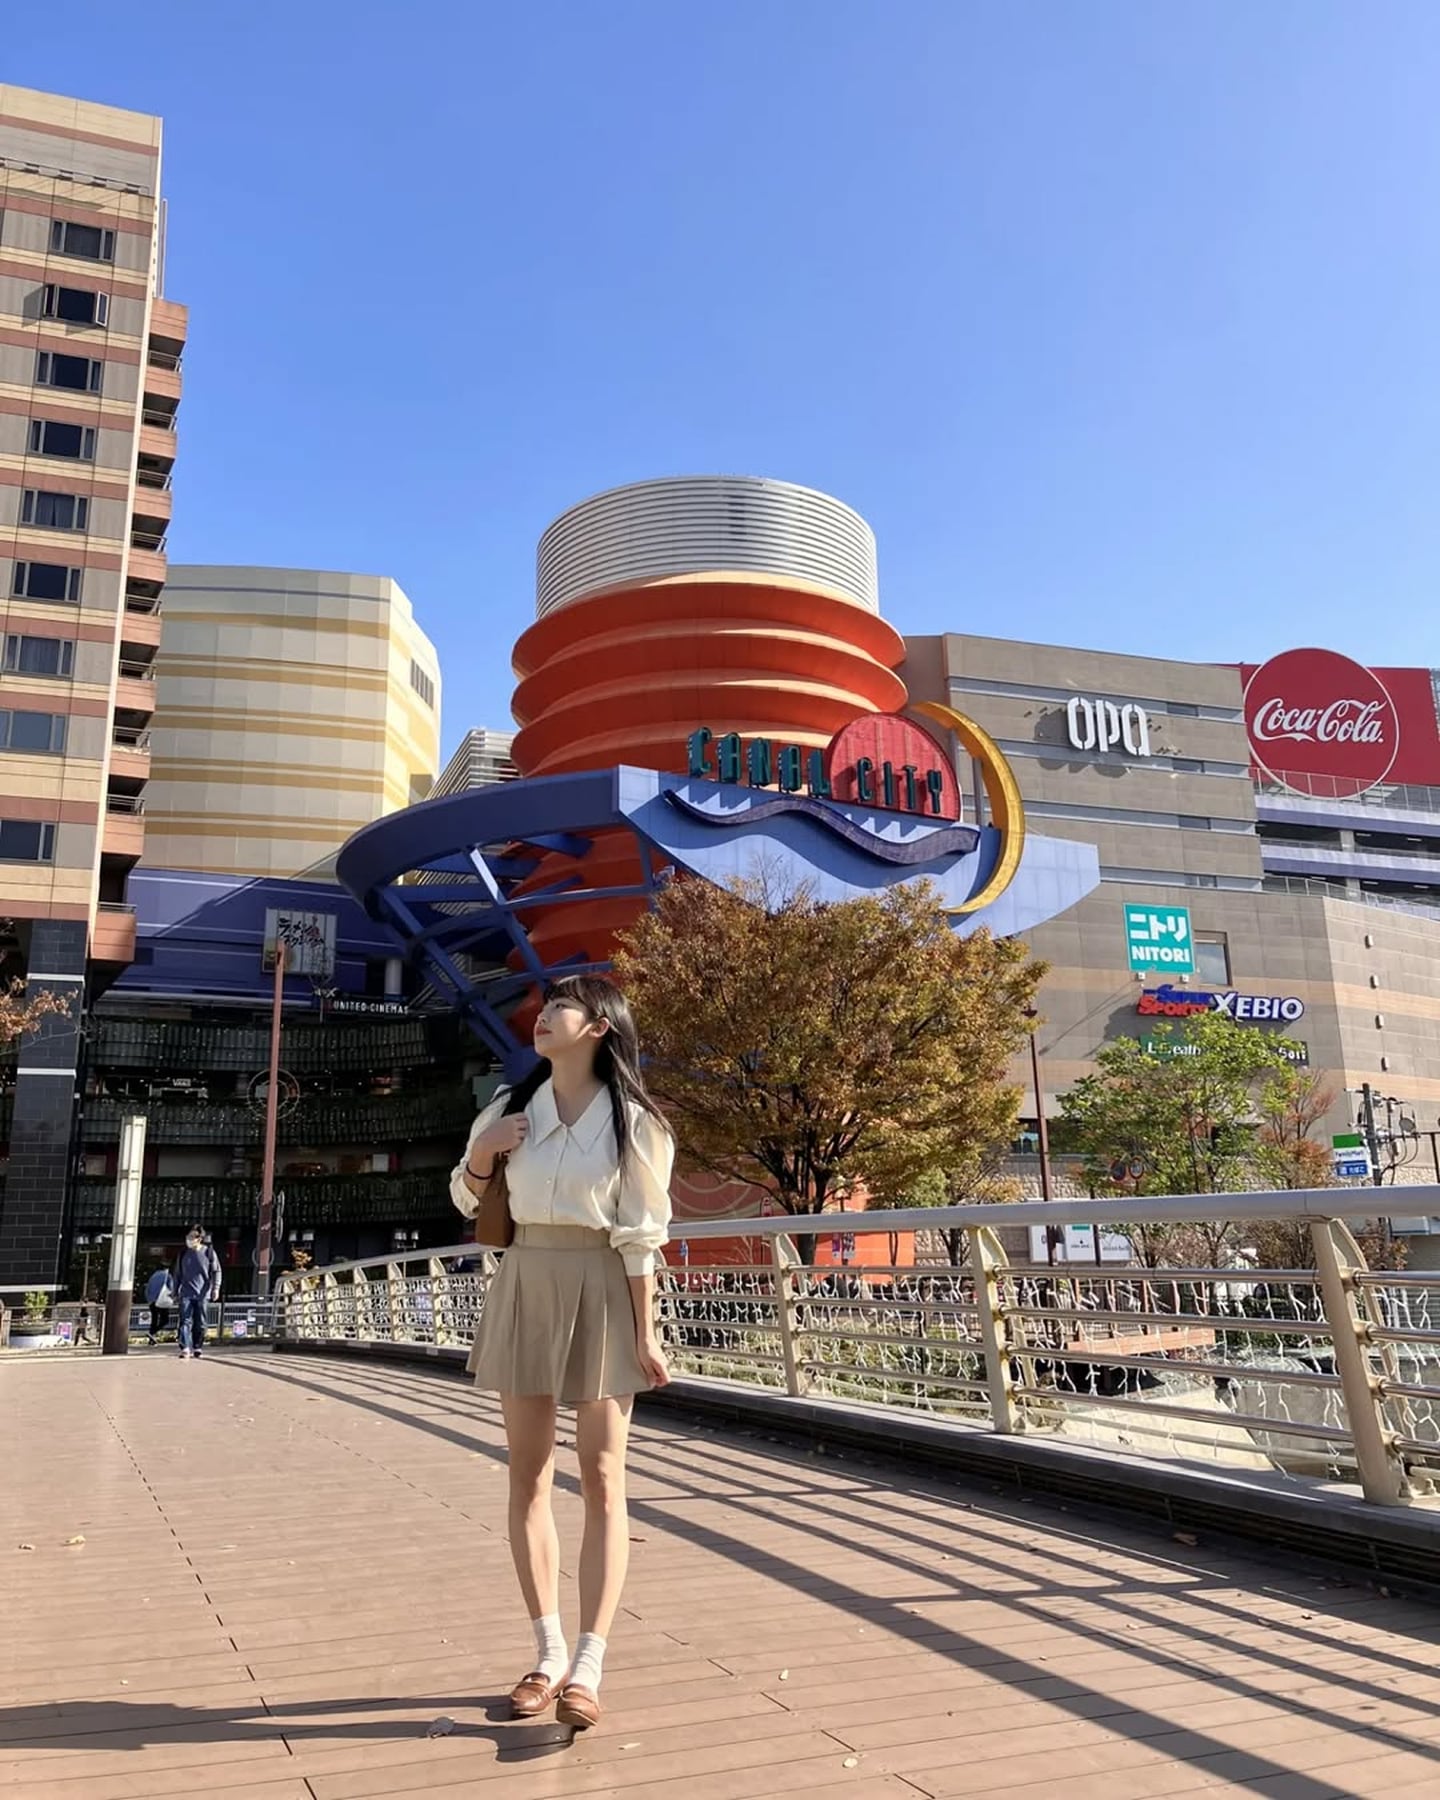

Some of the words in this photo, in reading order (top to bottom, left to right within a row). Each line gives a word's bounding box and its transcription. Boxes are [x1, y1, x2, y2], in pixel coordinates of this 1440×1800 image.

[1253, 697, 1387, 744] Coca-Cola
[687, 726, 831, 799] CANAL
[856, 756, 942, 814] CITY
[1129, 912, 1188, 943] ニトリ
[1131, 945, 1191, 964] NITORI
[1212, 992, 1304, 1020] XEBIO
